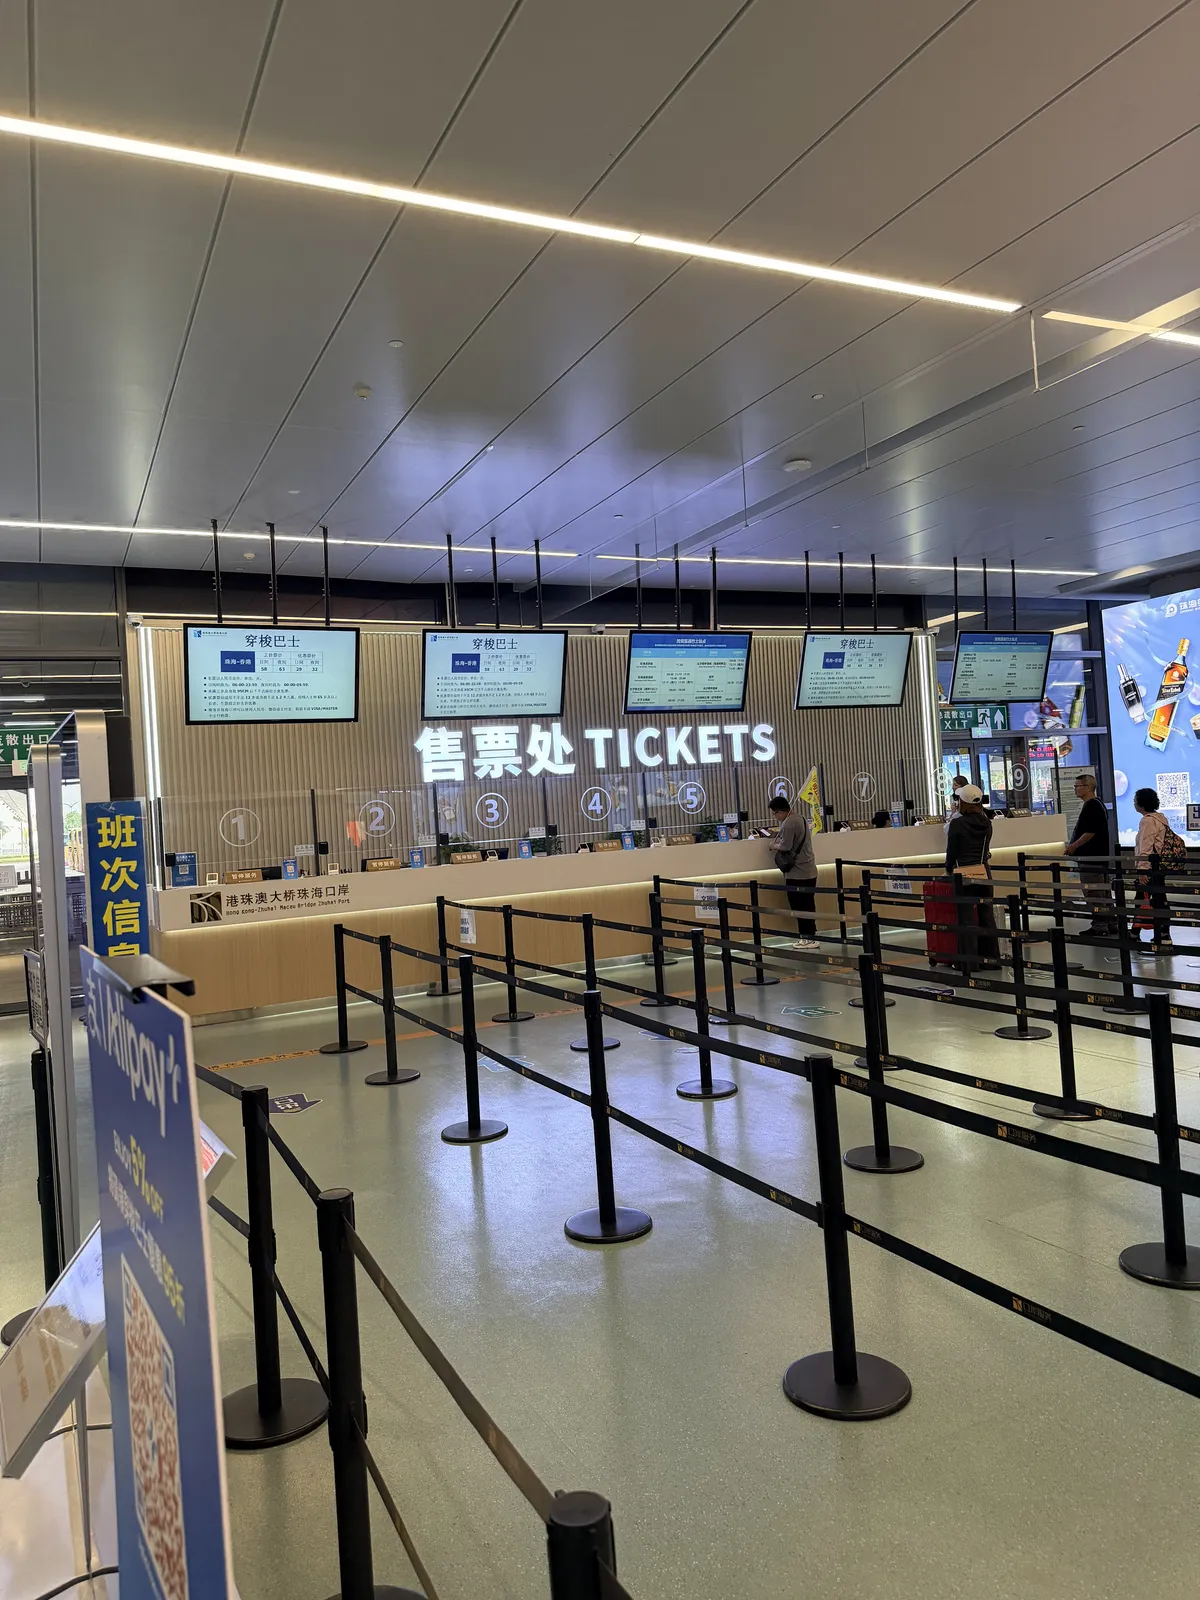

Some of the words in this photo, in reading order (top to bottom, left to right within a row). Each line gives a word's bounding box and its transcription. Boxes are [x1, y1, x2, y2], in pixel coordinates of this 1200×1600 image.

[1179, 599, 1200, 610] 珠海
[245, 634, 300, 648] 穿梭巴士
[472, 638, 518, 650] 穿梭巴士
[840, 639, 874, 649] 穿梭巴士
[414, 722, 576, 783] 售票处
[585, 723, 776, 768] TICKETS
[857, 777, 870, 799] 7
[1014, 768, 1024, 787] 9
[686, 787, 698, 809] 5
[775, 781, 787, 798] 6
[485, 799, 500, 823] 3
[588, 792, 603, 815] 4
[231, 814, 245, 841] 1
[369, 806, 386, 832] 2
[231, 872, 257, 880] 暂停服务
[226, 884, 350, 908] 港珠澳大桥珠海口岸
